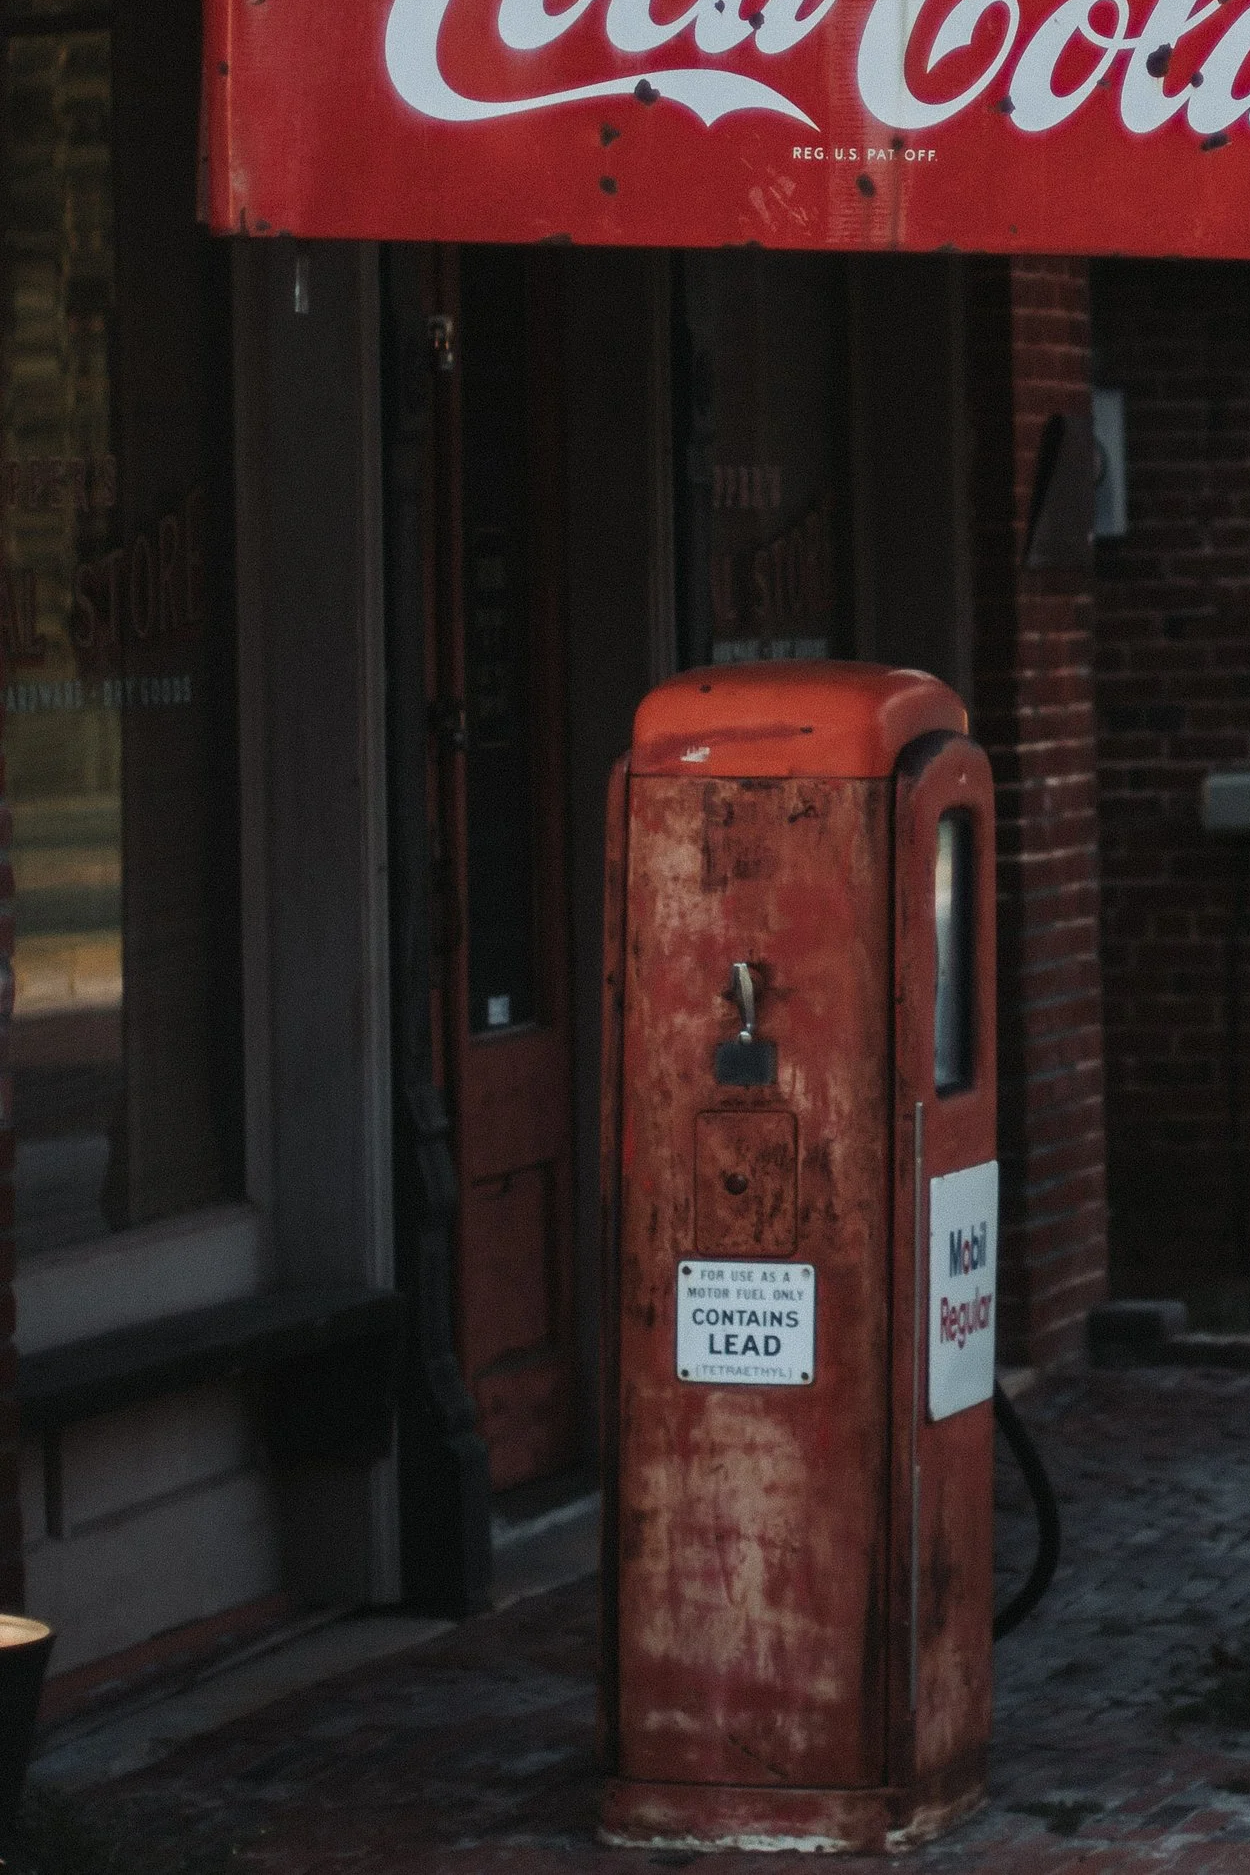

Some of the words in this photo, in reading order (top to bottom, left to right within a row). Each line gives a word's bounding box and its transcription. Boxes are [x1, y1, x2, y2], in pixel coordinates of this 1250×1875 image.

[792, 146, 829, 160] REG.
[834, 147, 860, 161] U.S.
[904, 149, 938, 162] OFF.
[75, 486, 205, 649] STORE
[949, 1221, 987, 1279] Mobil
[701, 1269, 724, 1282] FOR
[731, 1270, 754, 1283] USE
[761, 1271, 777, 1283] AS
[782, 1272, 791, 1283] A
[686, 1287, 730, 1300] MOTOR
[736, 1288, 766, 1301] FUEL
[773, 1289, 804, 1301] ONLY
[692, 1308, 799, 1328] CONTAINS
[940, 1286, 992, 1350] Regular
[708, 1333, 782, 1357] LEAD
